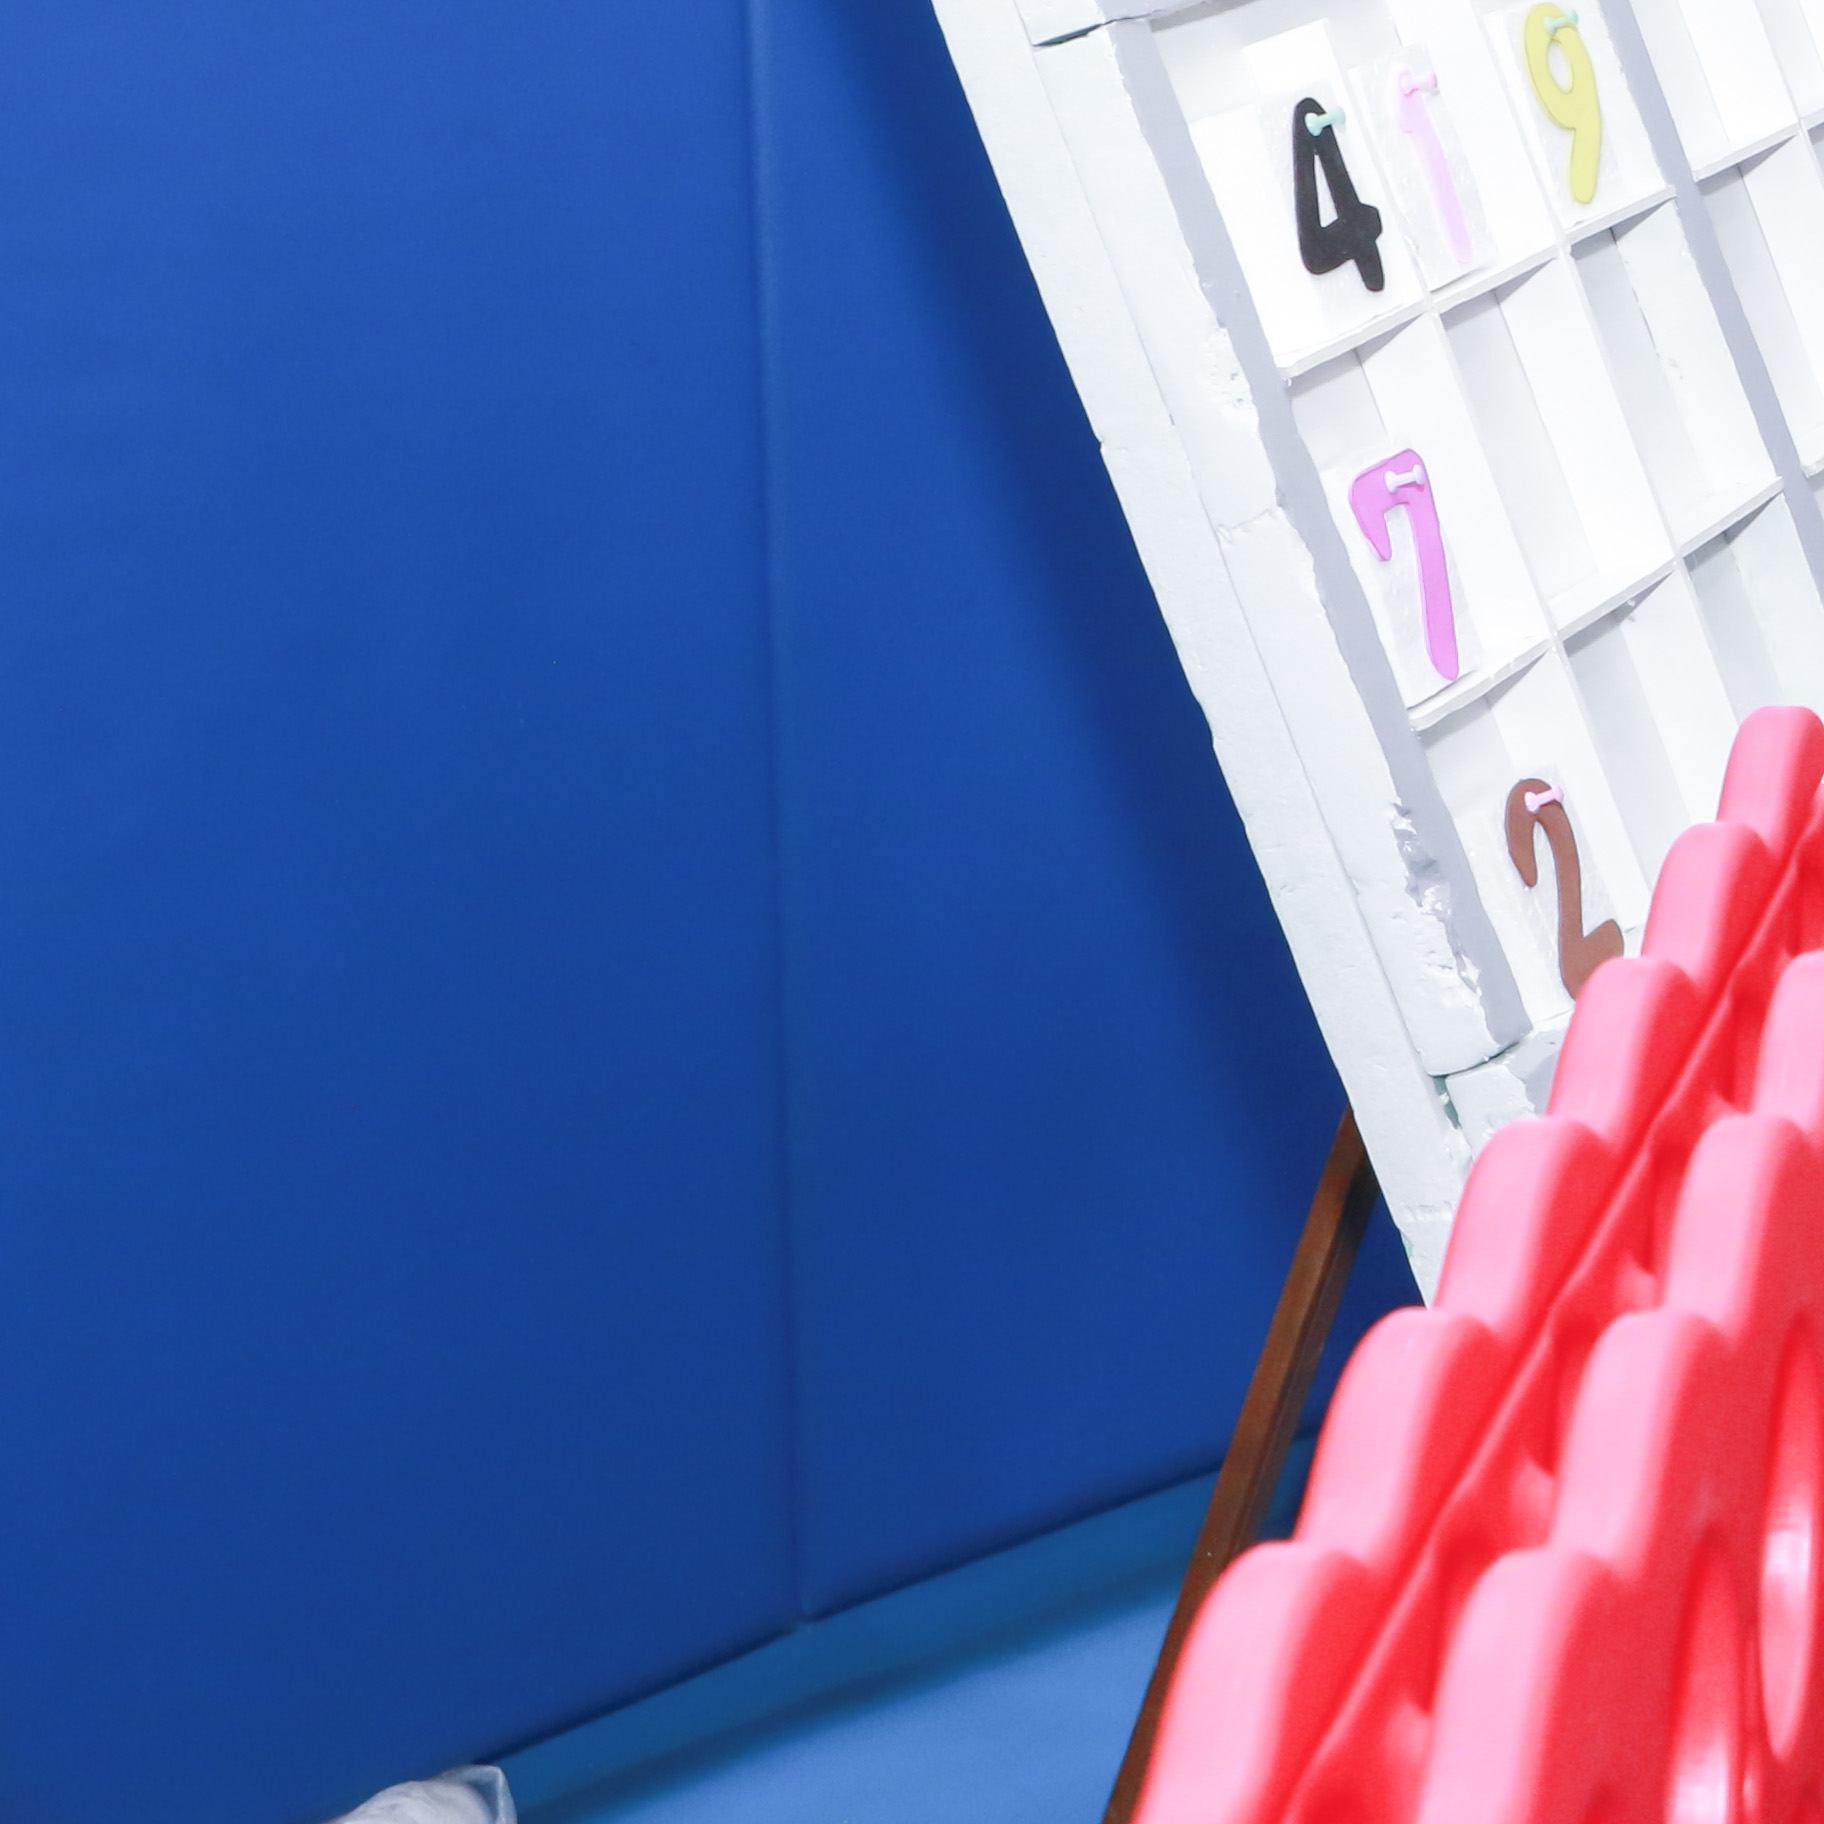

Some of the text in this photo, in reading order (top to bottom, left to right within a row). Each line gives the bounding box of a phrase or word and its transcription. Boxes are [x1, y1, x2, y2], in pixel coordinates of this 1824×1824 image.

[1293, 96, 1385, 293] 4
[1400, 69, 1474, 265] 1
[1523, 1, 1604, 205] 9
[1348, 448, 1460, 682] 7
[1504, 778, 1625, 1002] 2
